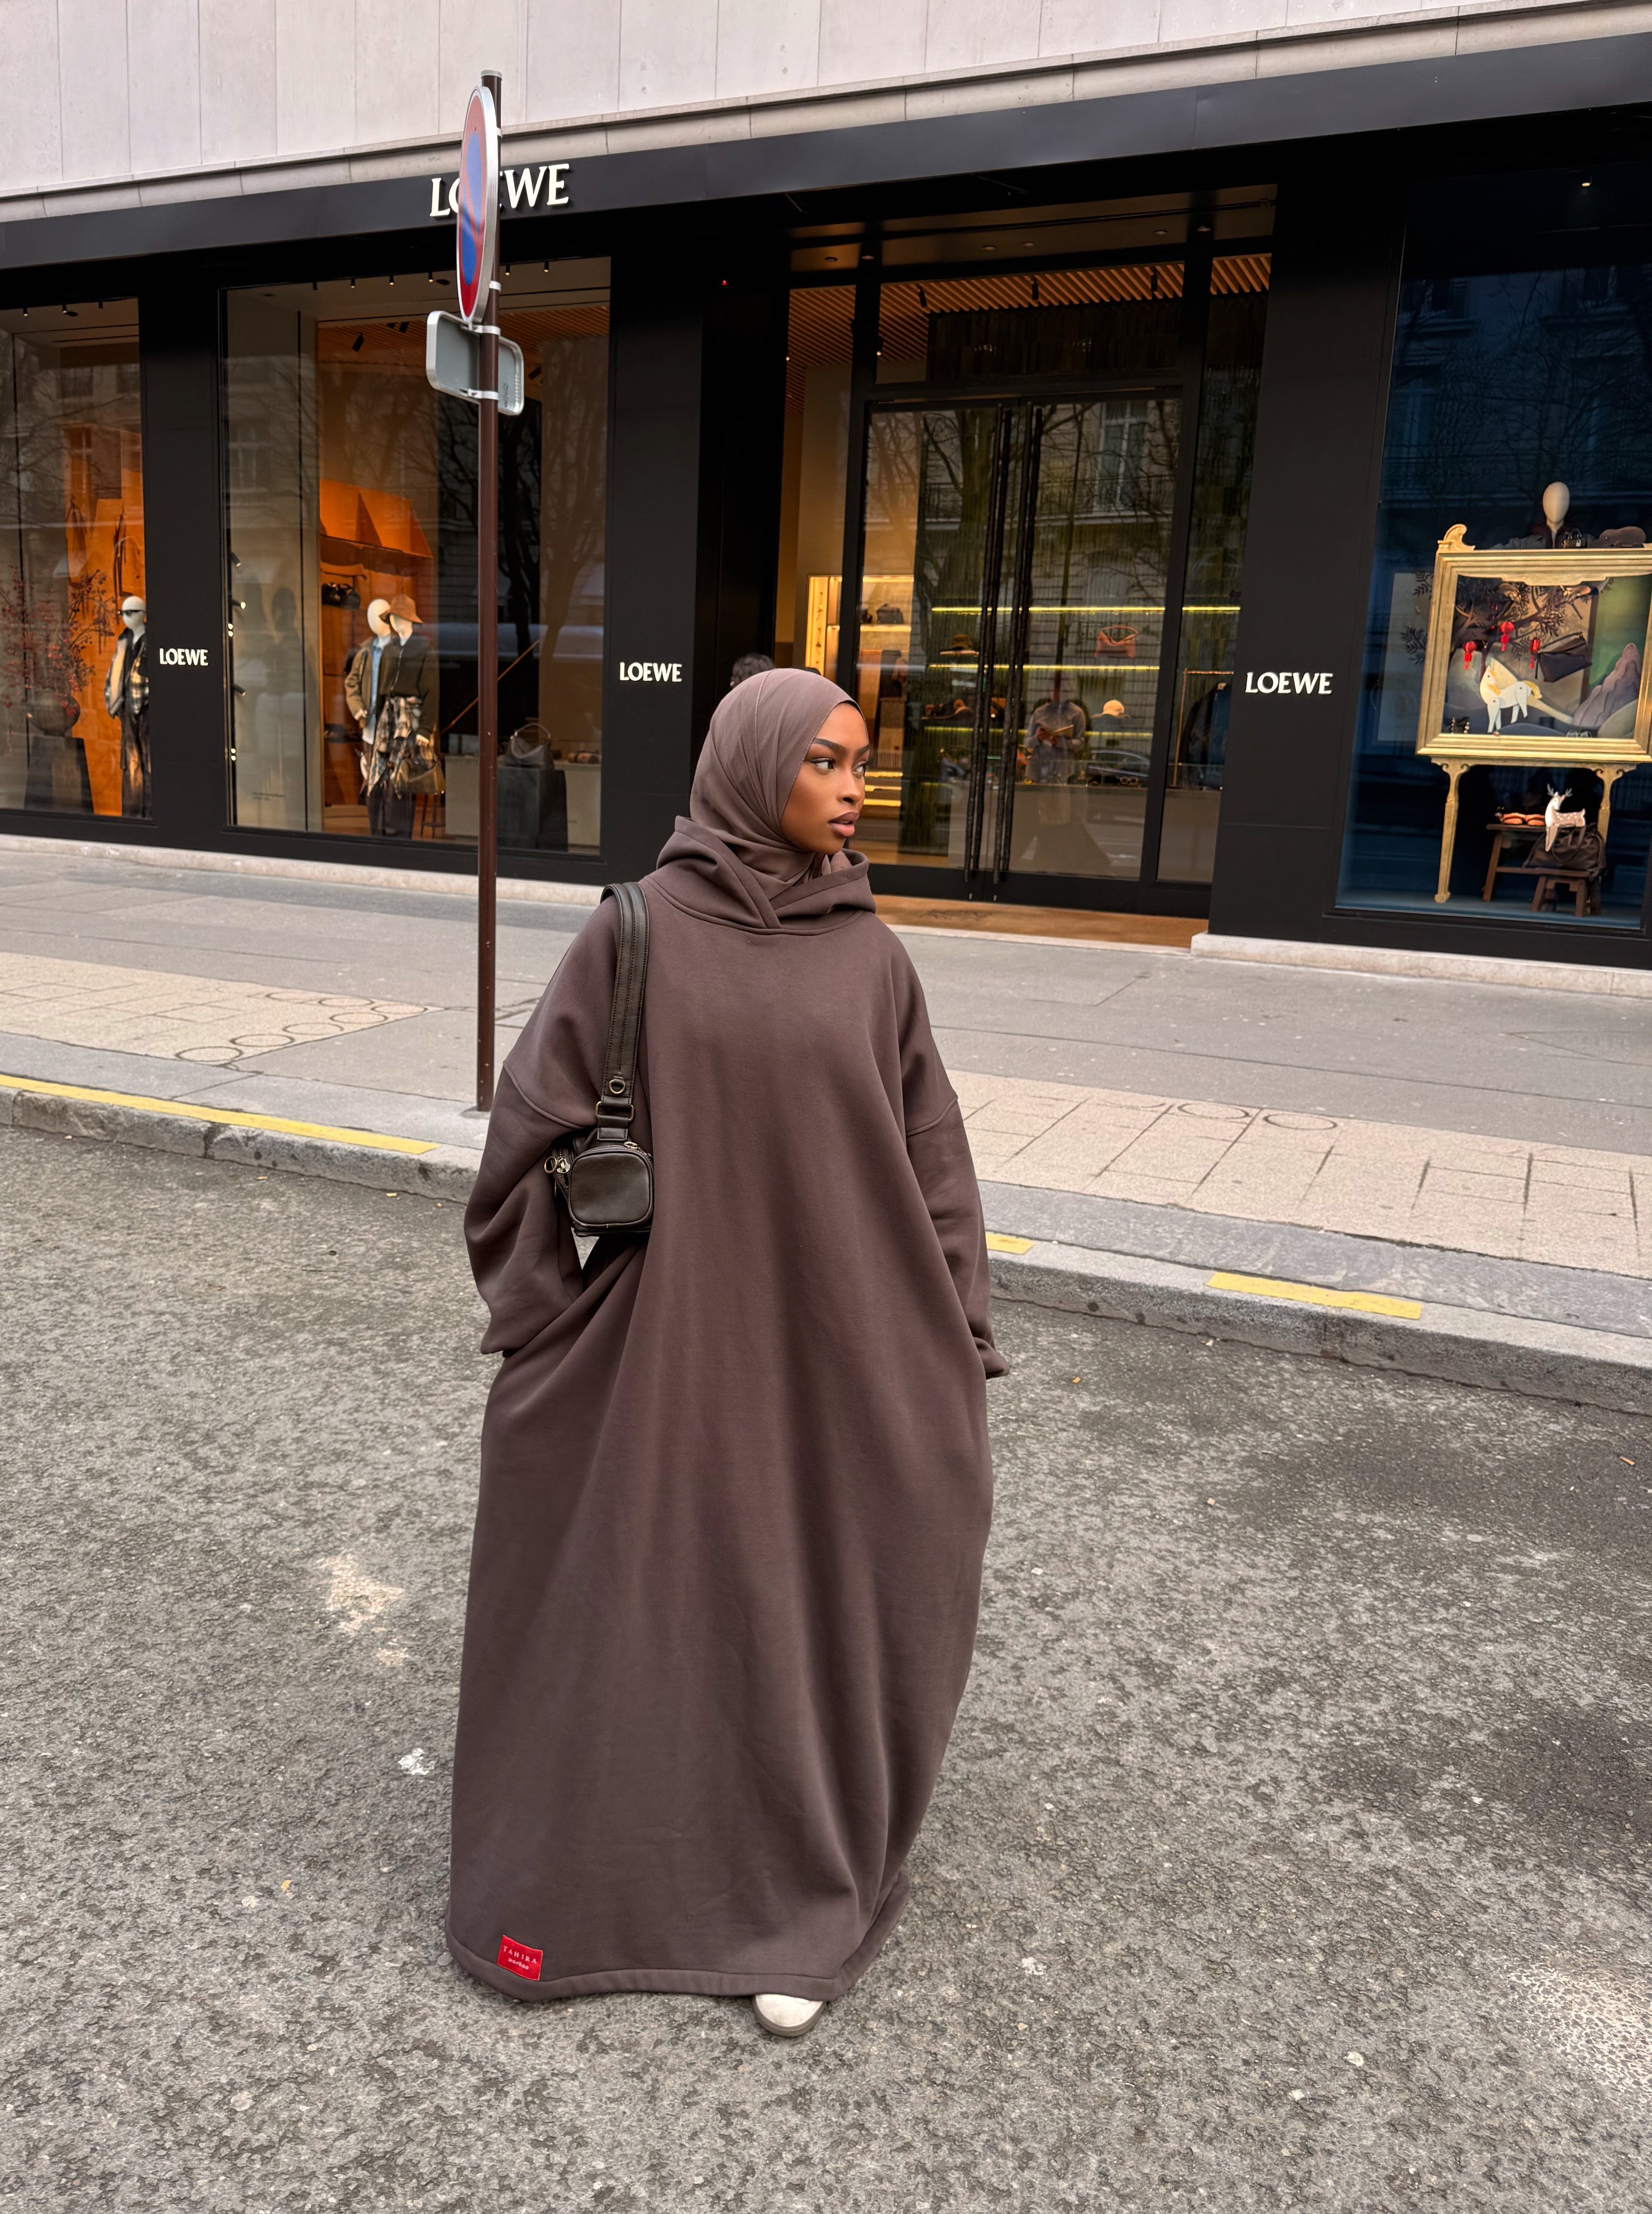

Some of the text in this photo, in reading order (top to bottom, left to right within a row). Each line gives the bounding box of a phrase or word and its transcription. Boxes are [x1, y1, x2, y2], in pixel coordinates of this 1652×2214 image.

[429, 163, 570, 217] LWE
[159, 648, 209, 666] LOEWE
[620, 662, 683, 682] LOEWE
[1245, 671, 1334, 695] LOEWE
[503, 1945, 537, 1964] TAHIRA
